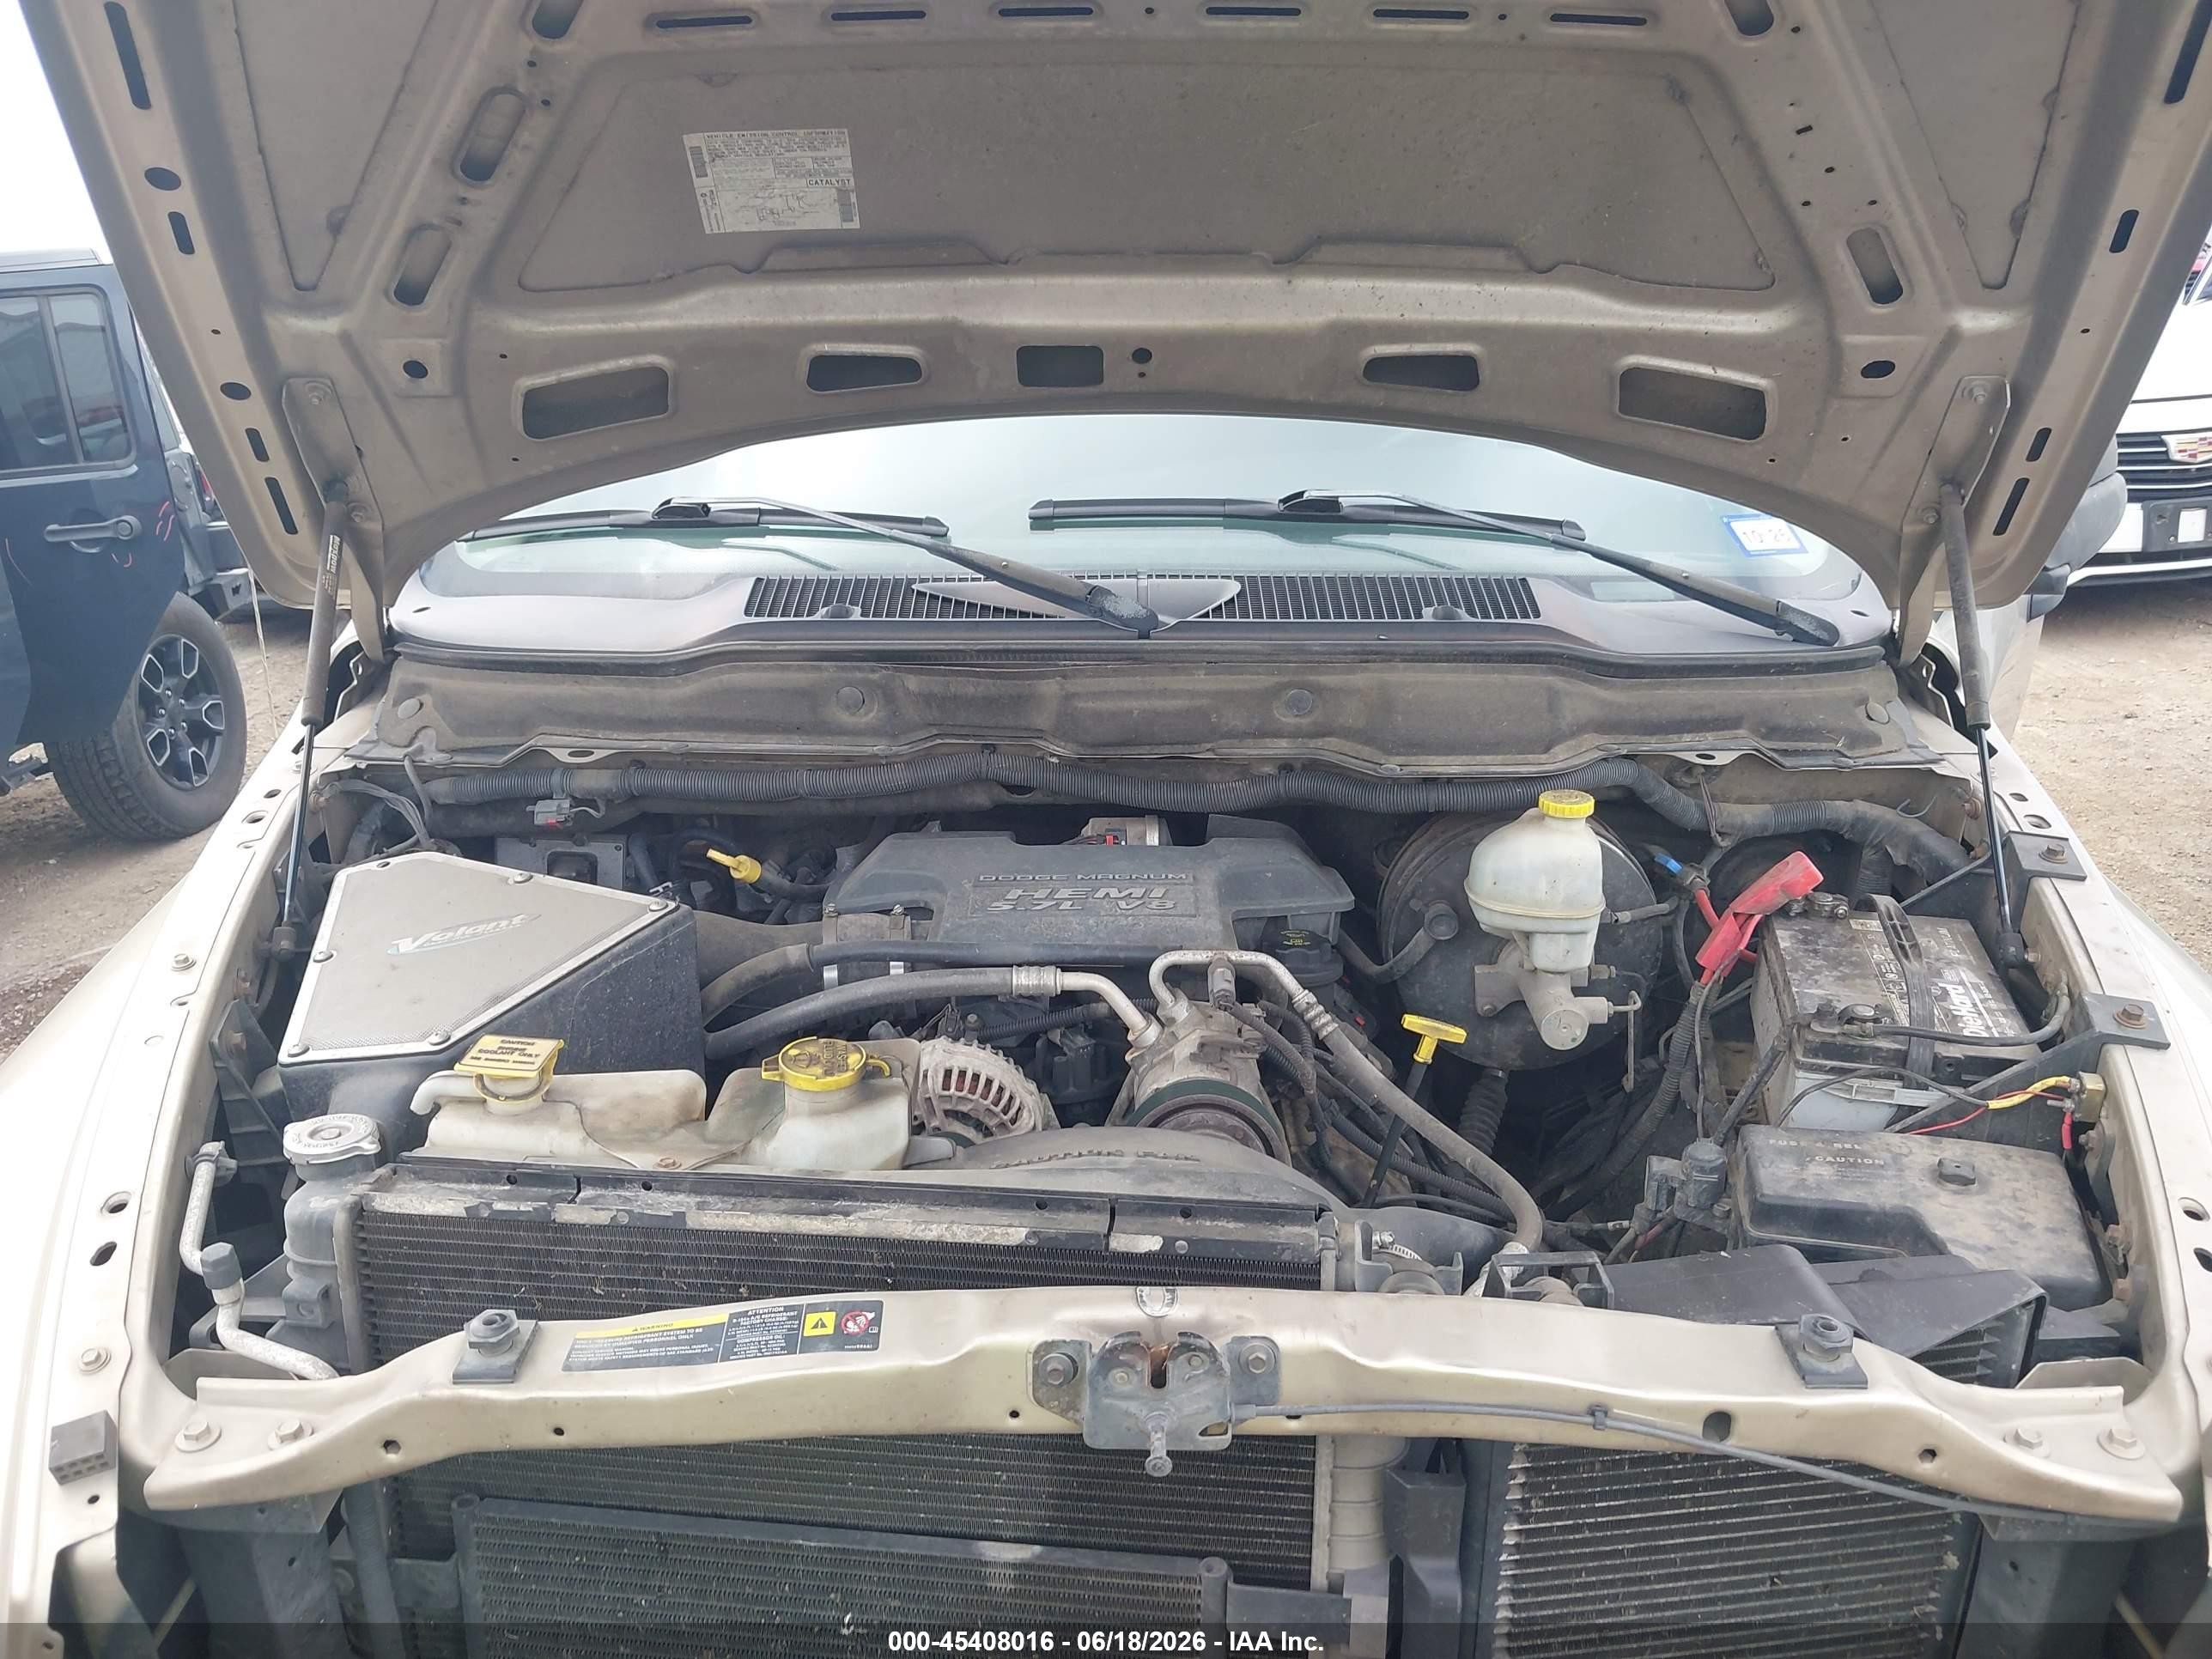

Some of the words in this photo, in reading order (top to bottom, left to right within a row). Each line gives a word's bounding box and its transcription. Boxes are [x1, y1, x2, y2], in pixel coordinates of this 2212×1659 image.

[808, 178, 851, 186] CATALYST
[1076, 872, 1187, 881] MAGNUM
[1005, 887, 1169, 901] HEMI
[987, 900, 1084, 912] 5.7L
[1115, 900, 1176, 911] V8
[391, 913, 531, 952] Volant
[1937, 981, 1991, 1037] DieHard
[477, 1048, 515, 1056] COOLANT
[1814, 1155, 1885, 1165] CAUTION
[747, 1306, 784, 1316] ATTENTION
[761, 1310, 798, 1319] REFRIGERANT
[639, 1322, 674, 1332] WARNING
